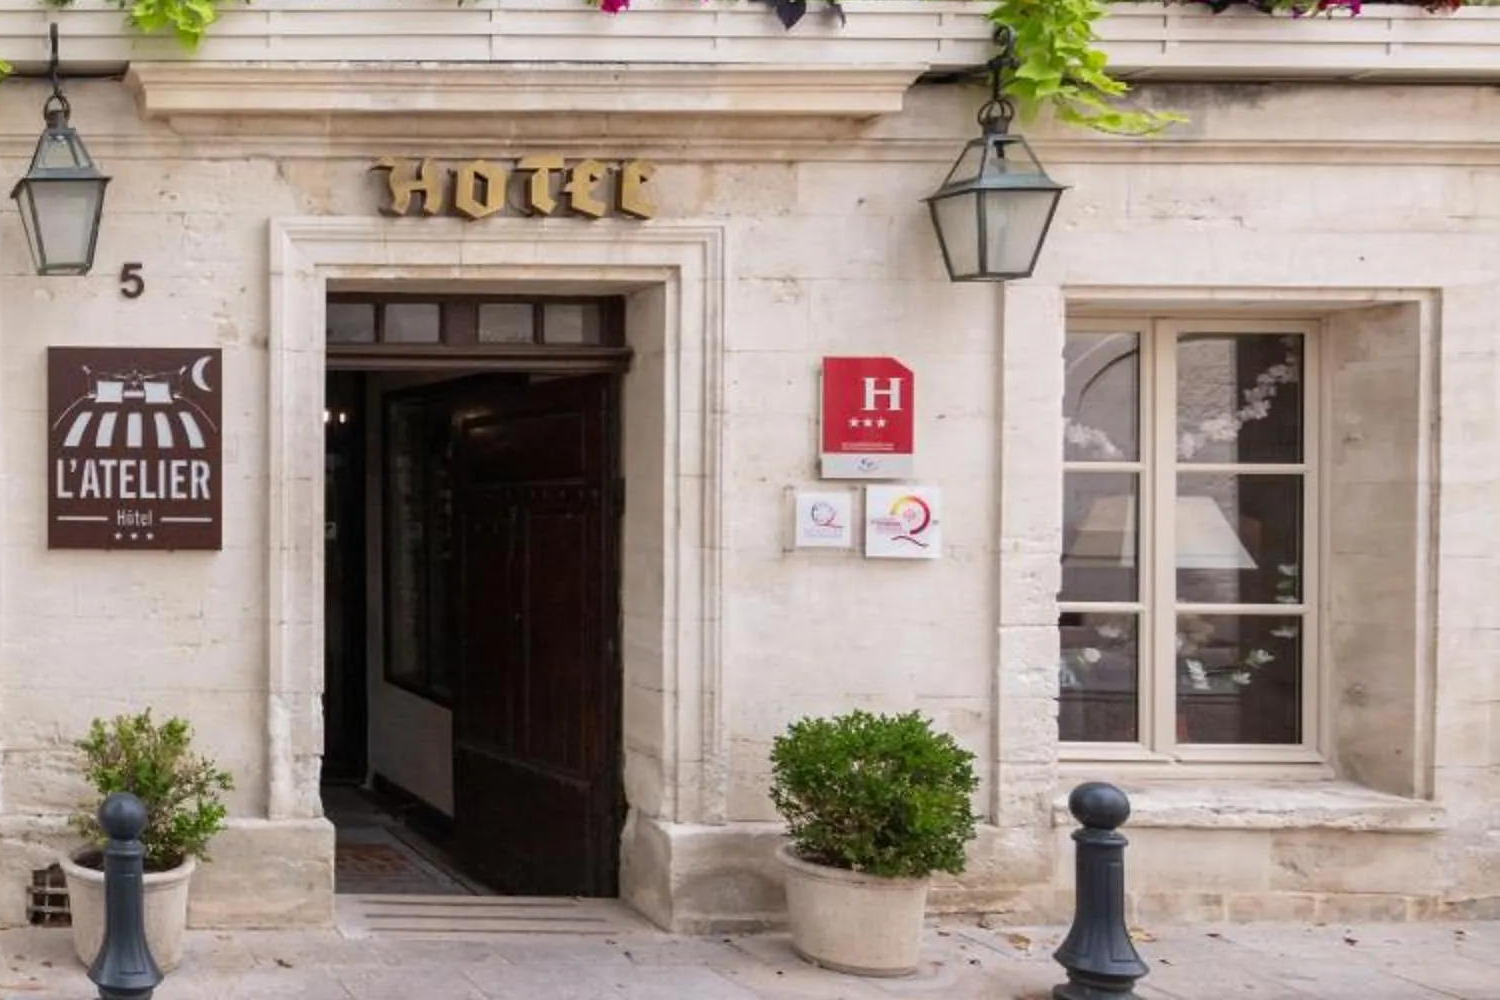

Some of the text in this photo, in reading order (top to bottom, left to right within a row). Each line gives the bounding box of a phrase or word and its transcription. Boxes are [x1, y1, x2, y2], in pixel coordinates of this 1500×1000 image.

[119, 262, 145, 299] 5
[860, 376, 904, 412] H
[56, 458, 211, 500] L'ATELIER
[116, 507, 154, 527] Hôtel
